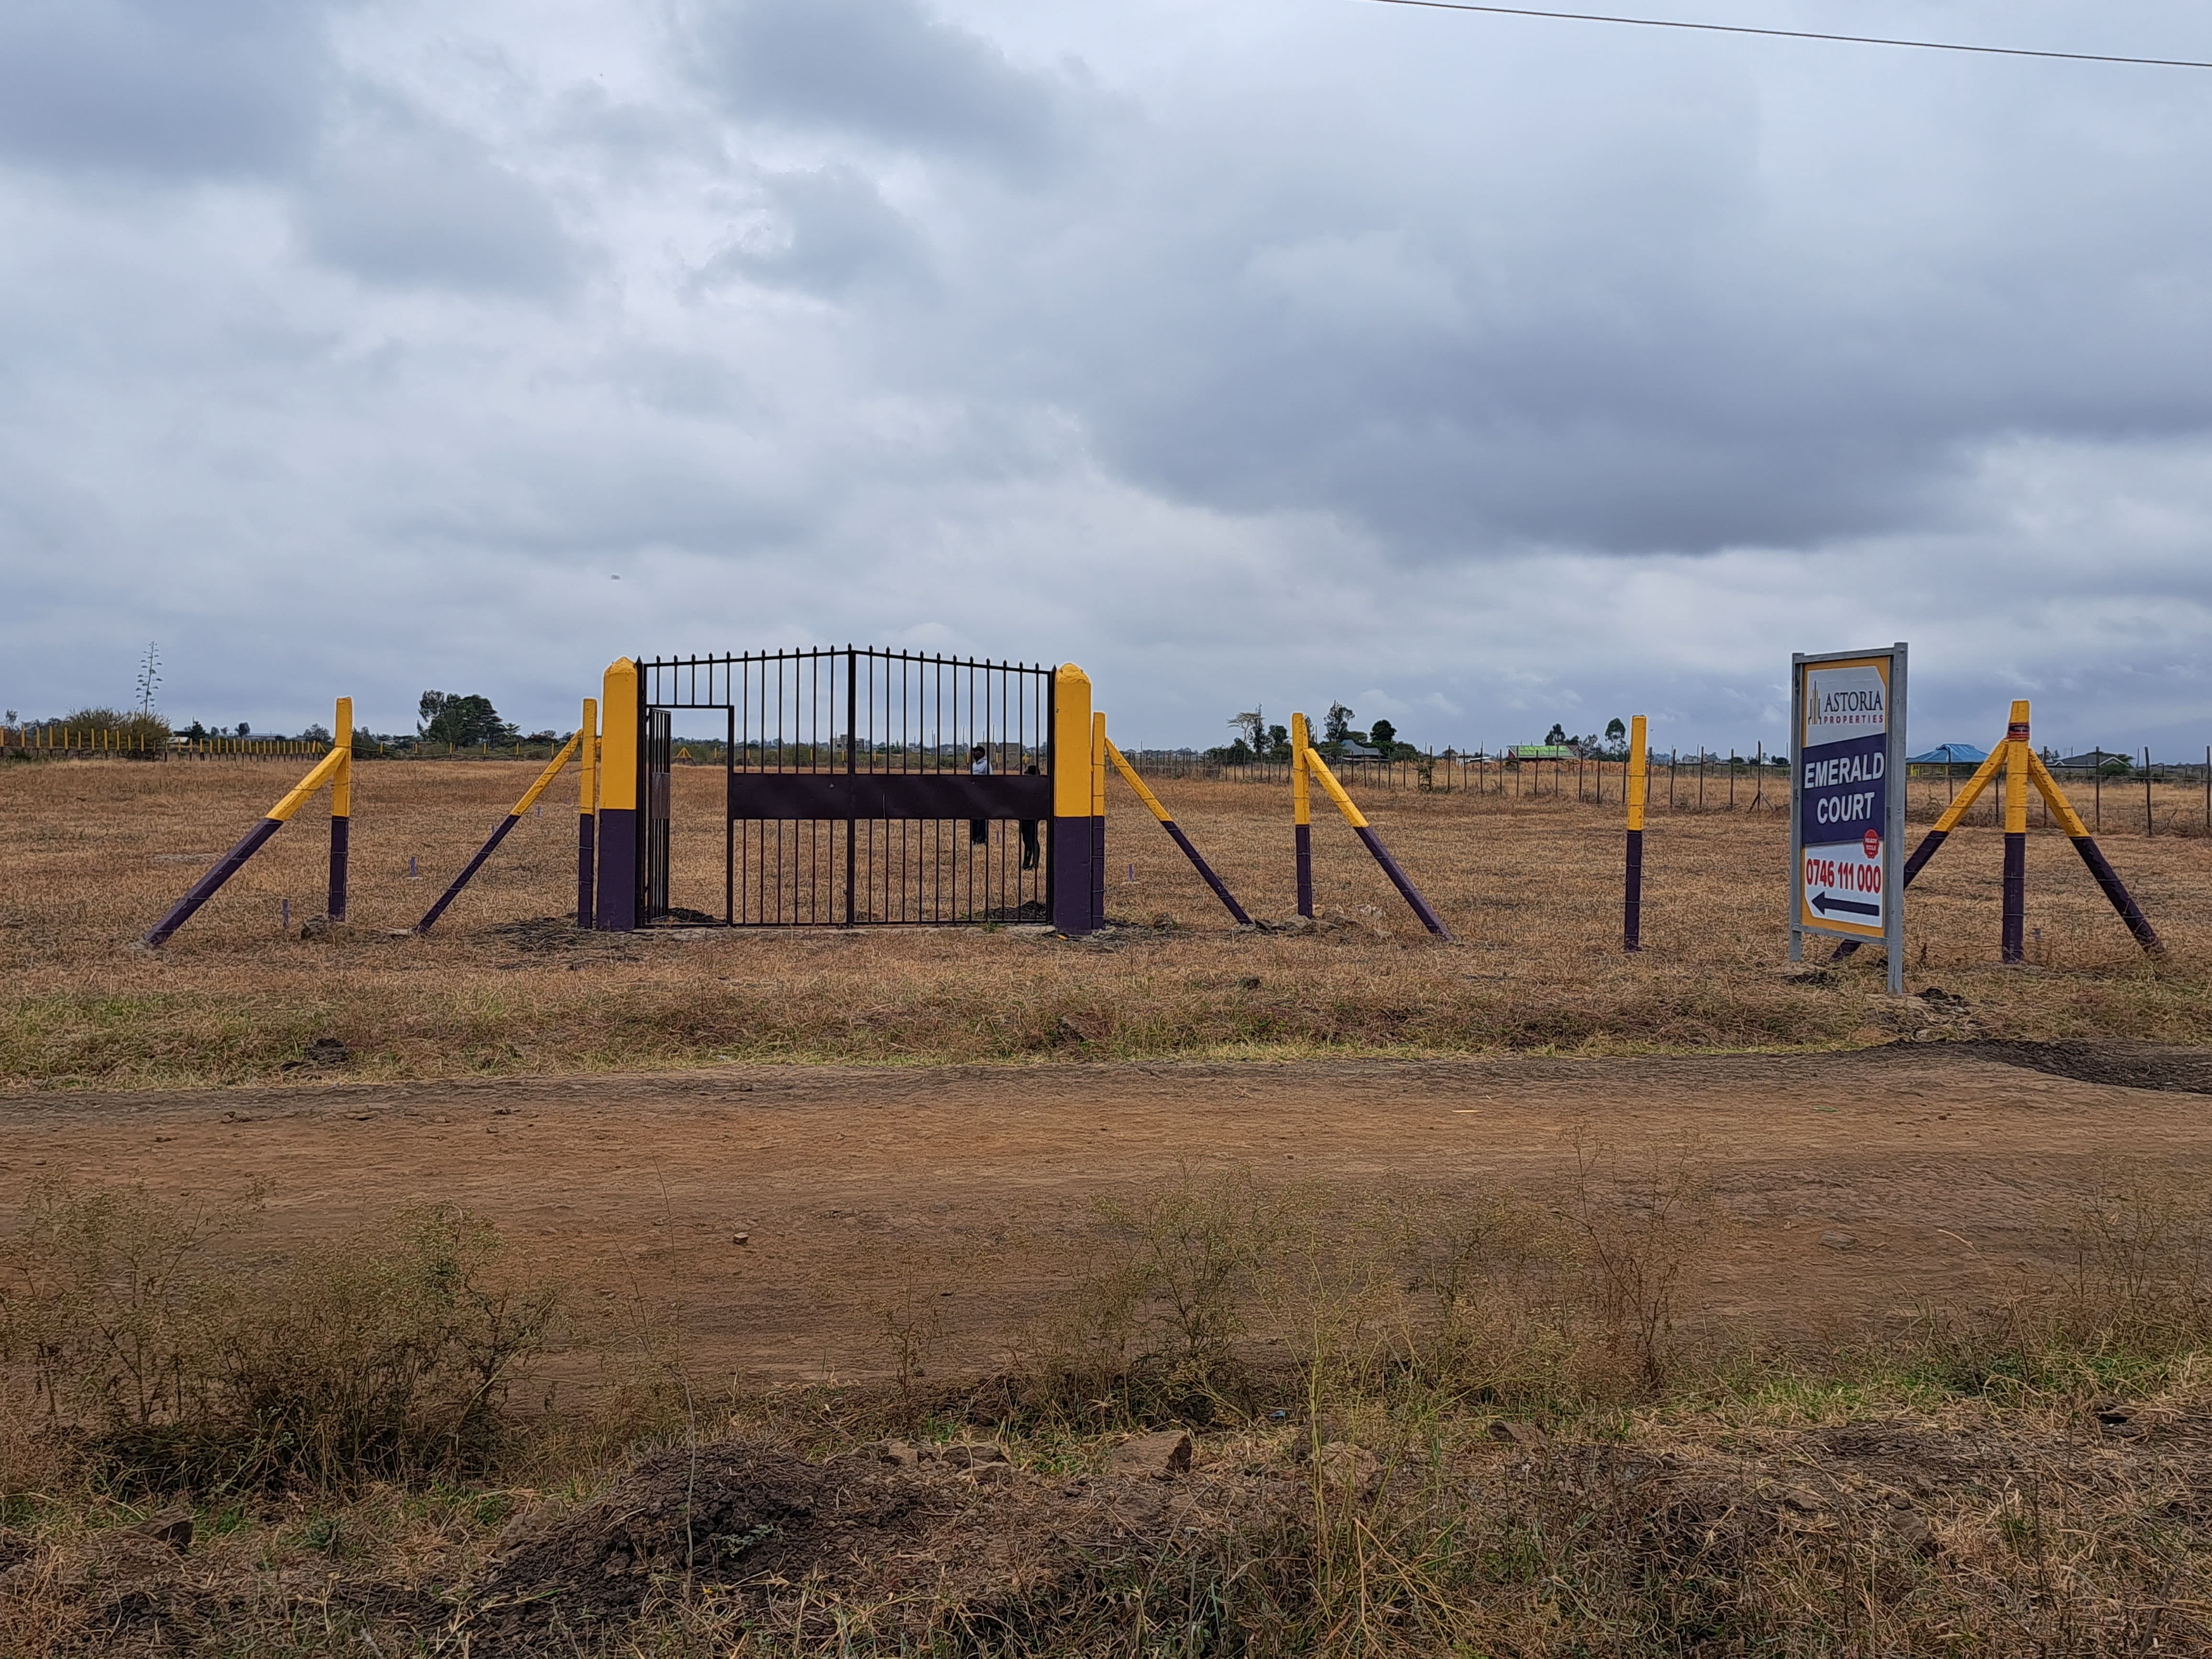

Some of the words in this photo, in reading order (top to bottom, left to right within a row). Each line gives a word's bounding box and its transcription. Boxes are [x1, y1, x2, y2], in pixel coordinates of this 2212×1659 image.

[1824, 690, 1883, 712] ASTORIA
[1824, 715, 1883, 724] PROPERTIES
[1804, 752, 1884, 789] EMERALD
[1817, 792, 1875, 824] COURT
[1806, 858, 1835, 887] 0746
[1837, 862, 1854, 890] 111
[1857, 864, 1881, 894] 000
